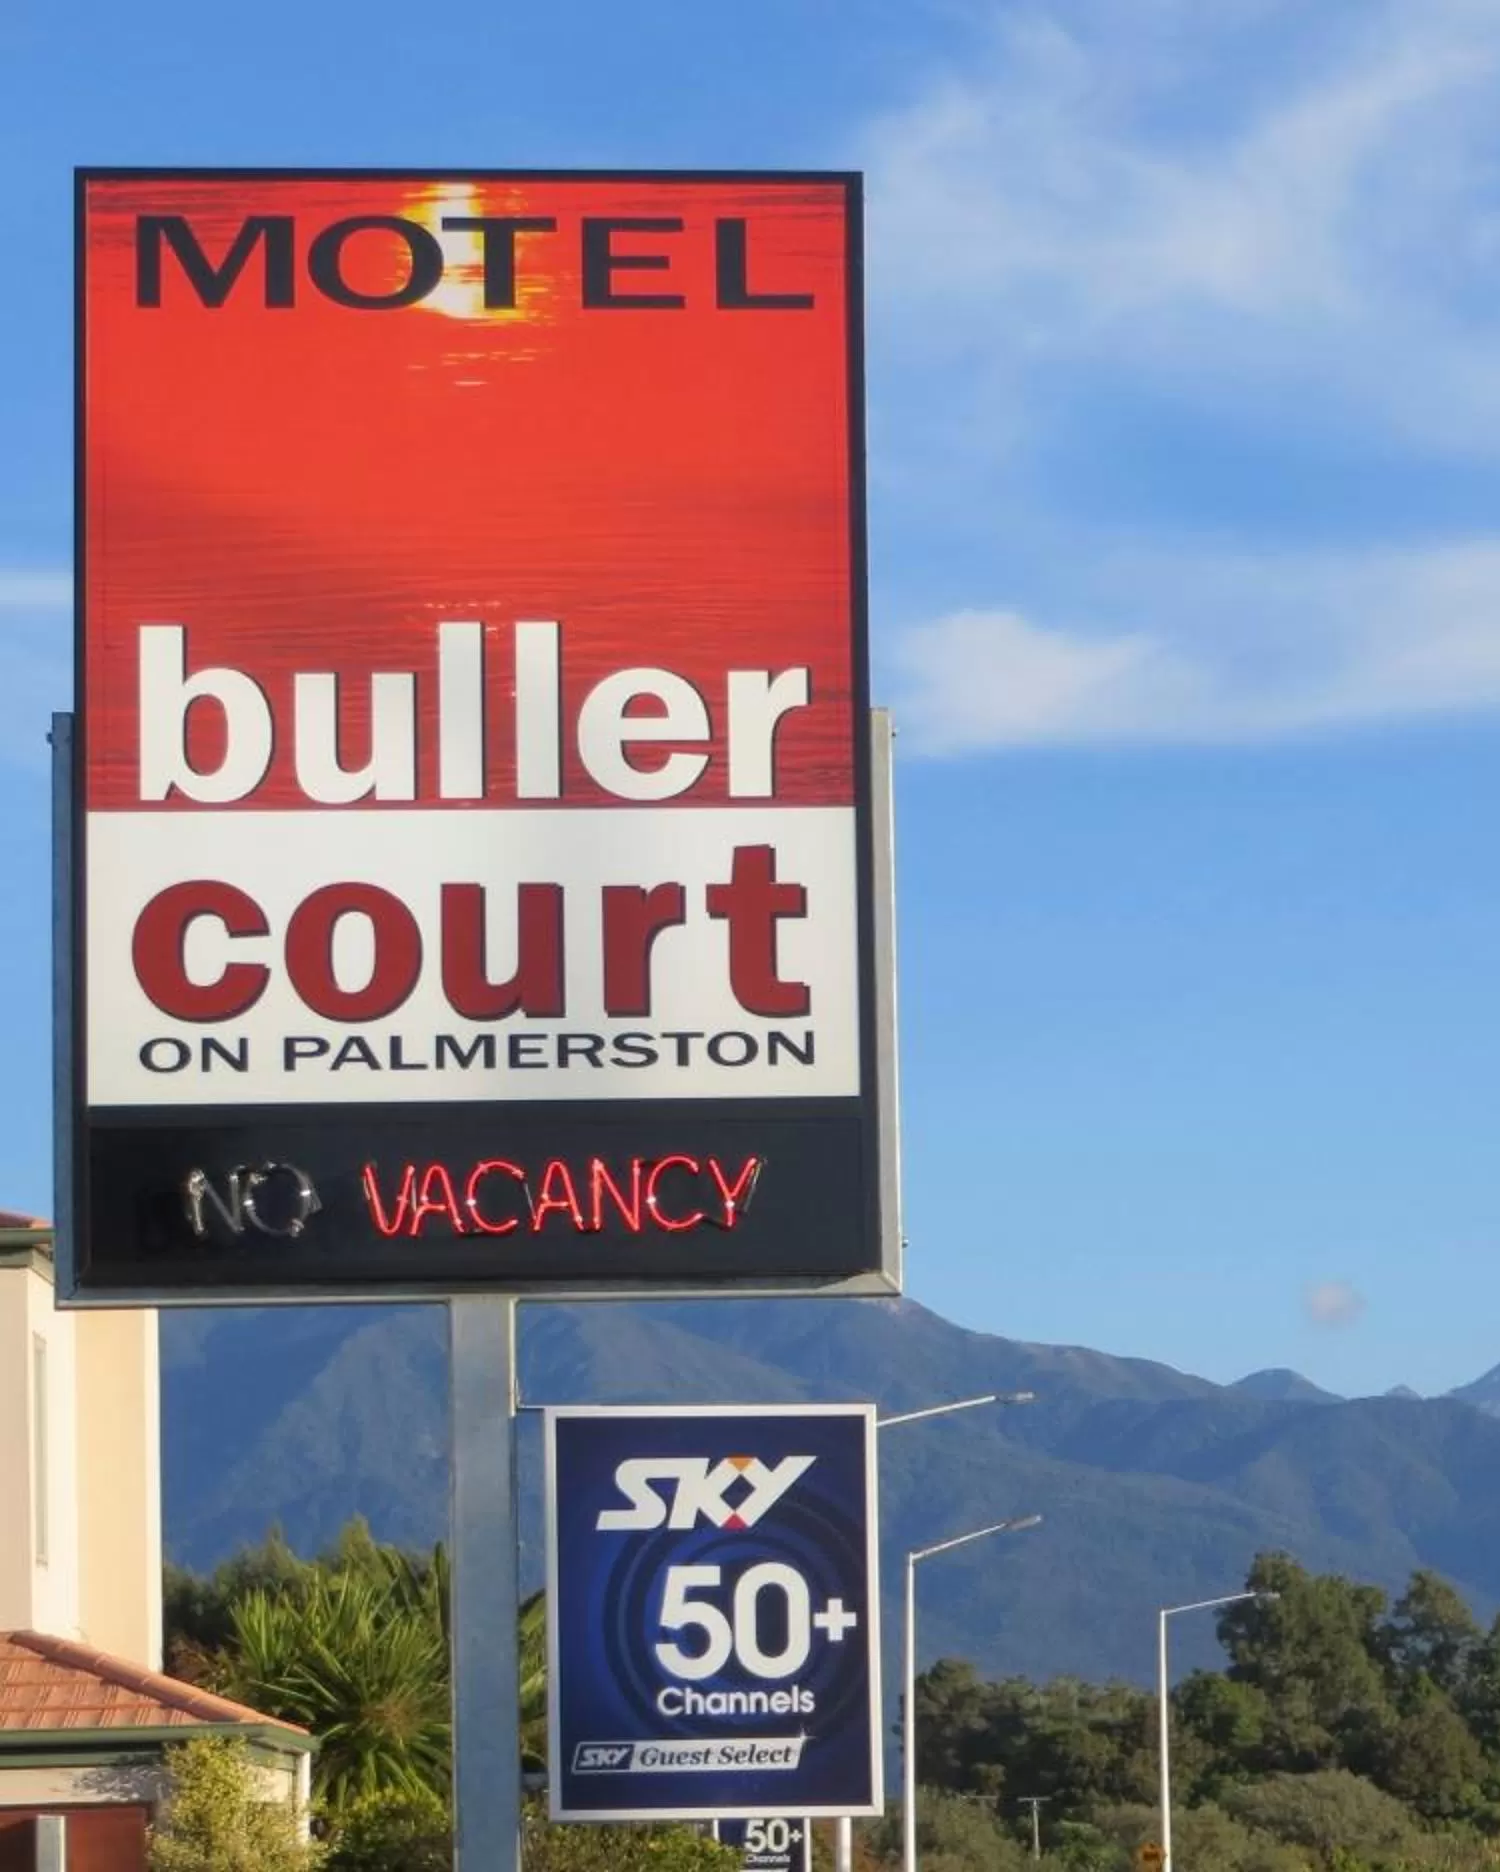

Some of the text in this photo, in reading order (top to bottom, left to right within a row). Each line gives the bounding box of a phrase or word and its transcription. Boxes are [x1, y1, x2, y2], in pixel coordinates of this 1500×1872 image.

[135, 215, 814, 310] MOTEL
[138, 620, 810, 804] buller
[131, 844, 811, 1023] court
[138, 1030, 816, 1073] ON PALMERSTON
[187, 1154, 764, 1238] NO VACANCY
[596, 1454, 817, 1530] SKY
[655, 1562, 857, 1680] 50+
[657, 1685, 815, 1717] Channels
[577, 1743, 792, 1768] SKY Guest Select
[744, 1819, 803, 1853] 50+
